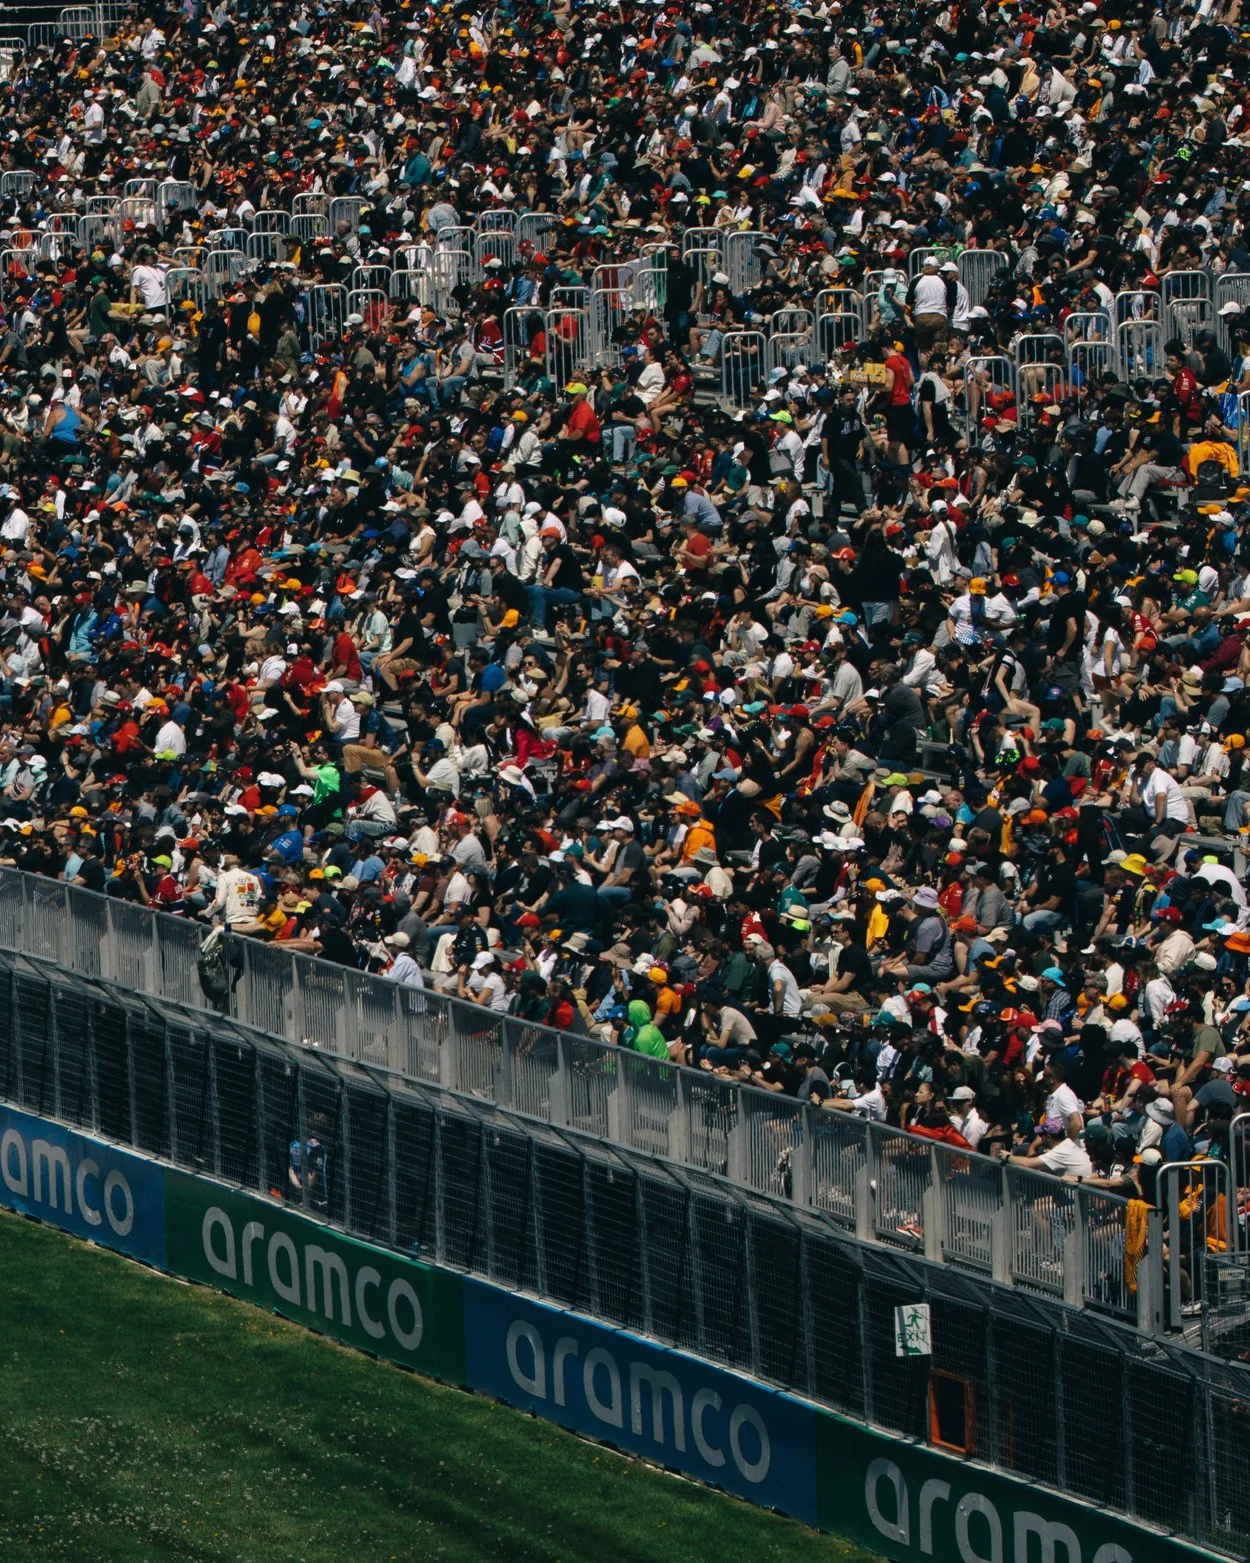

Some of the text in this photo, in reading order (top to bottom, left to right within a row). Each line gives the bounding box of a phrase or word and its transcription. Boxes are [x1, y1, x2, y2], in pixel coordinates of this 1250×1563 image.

[202, 1207, 422, 1350] aramco
[897, 1331, 927, 1343] EXIT
[507, 1320, 770, 1482] aramco
[865, 1458, 1132, 1563] aram
